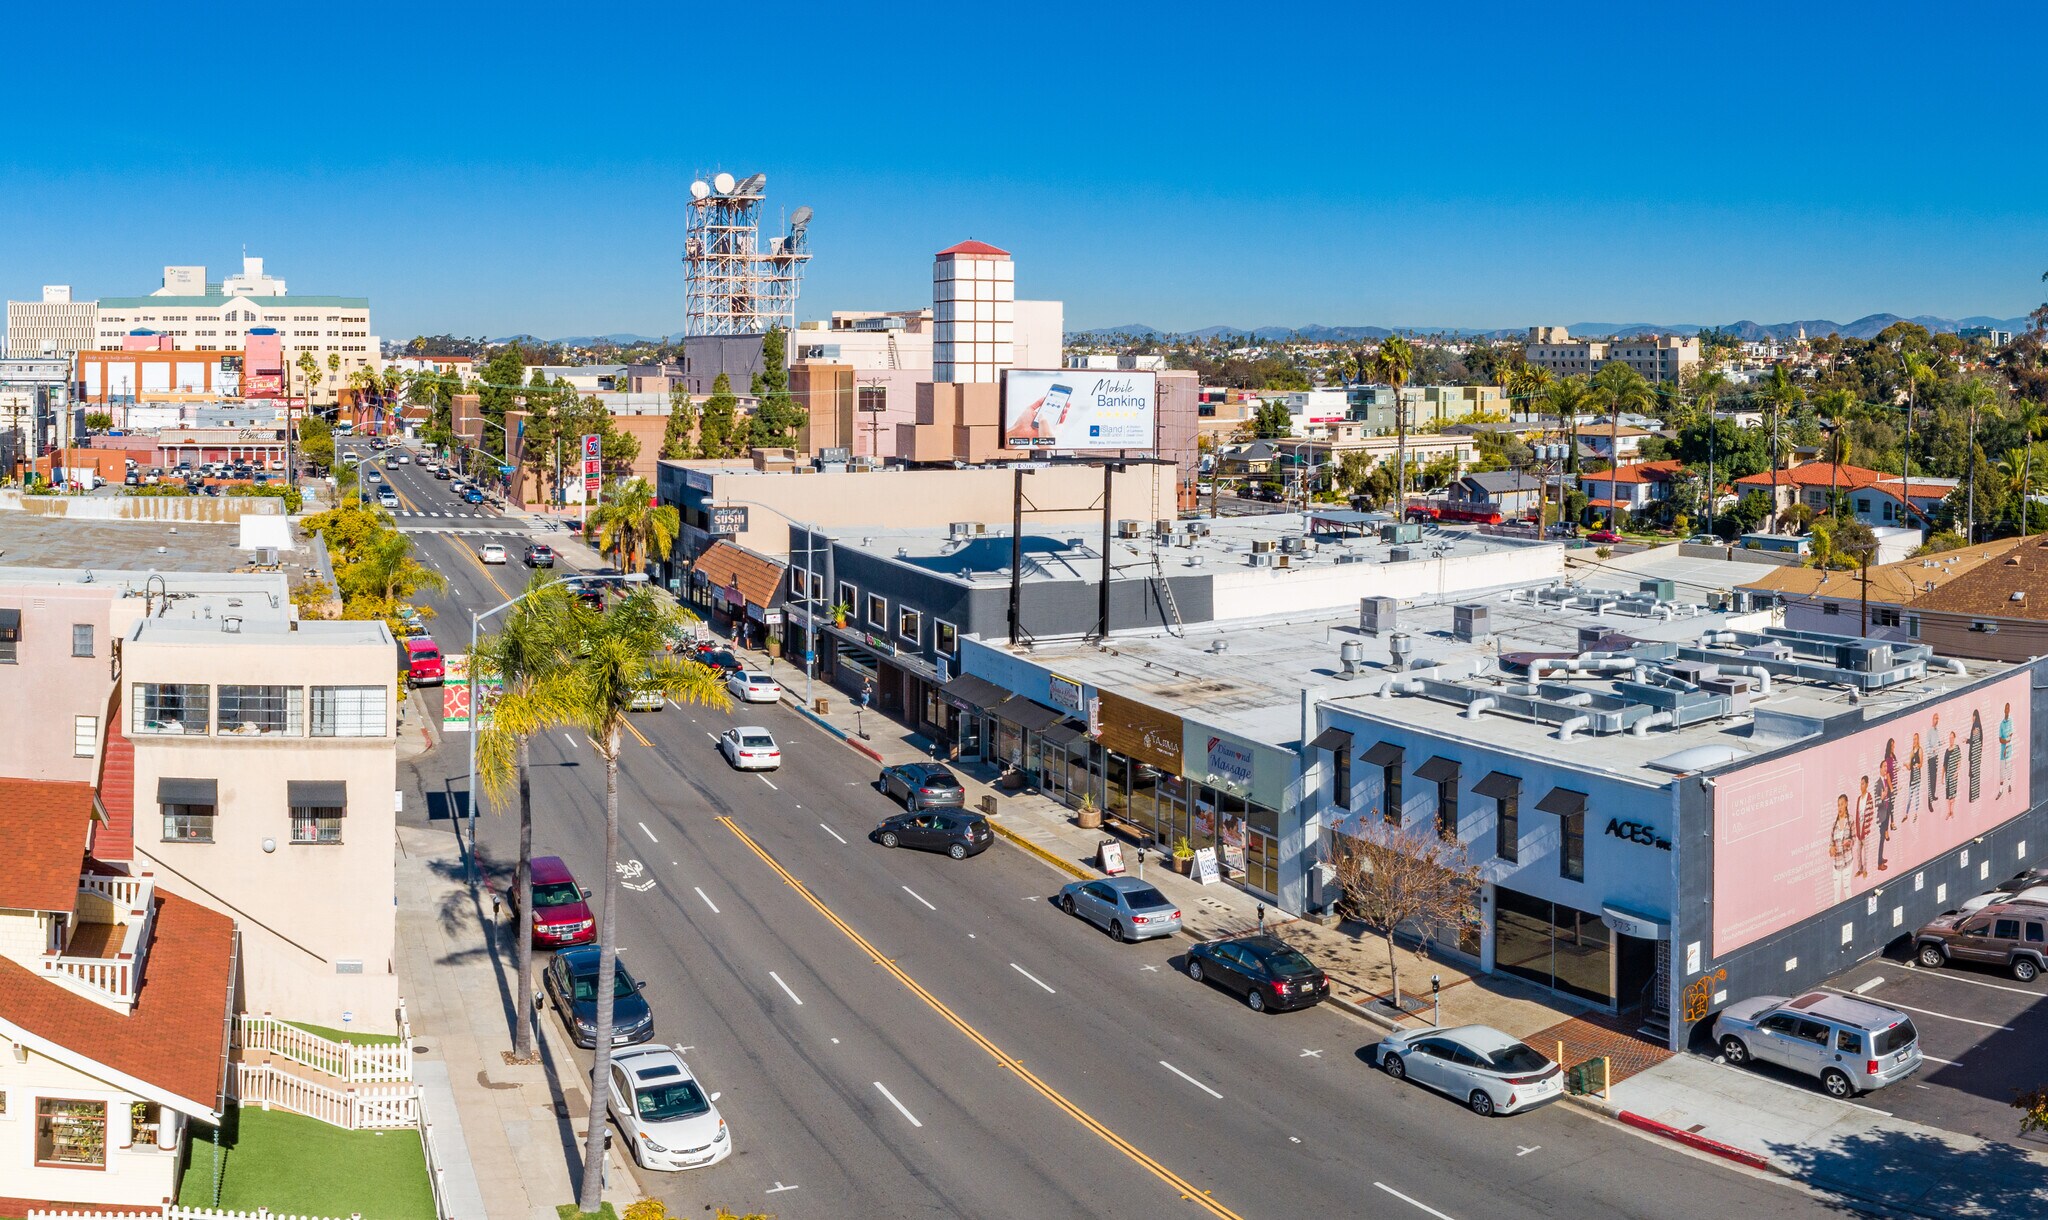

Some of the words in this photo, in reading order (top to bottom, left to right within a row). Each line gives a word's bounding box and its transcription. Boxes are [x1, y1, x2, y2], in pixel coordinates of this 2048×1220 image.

[1090, 378, 1135, 396] Mobile
[1097, 394, 1146, 410] Banking
[589, 441, 598, 452] 76
[714, 514, 745, 524] SUSHI
[719, 524, 740, 532] BAR
[1150, 734, 1179, 753] TAJIMA
[1210, 754, 1252, 781] Massage
[1604, 817, 1655, 846] ACES
